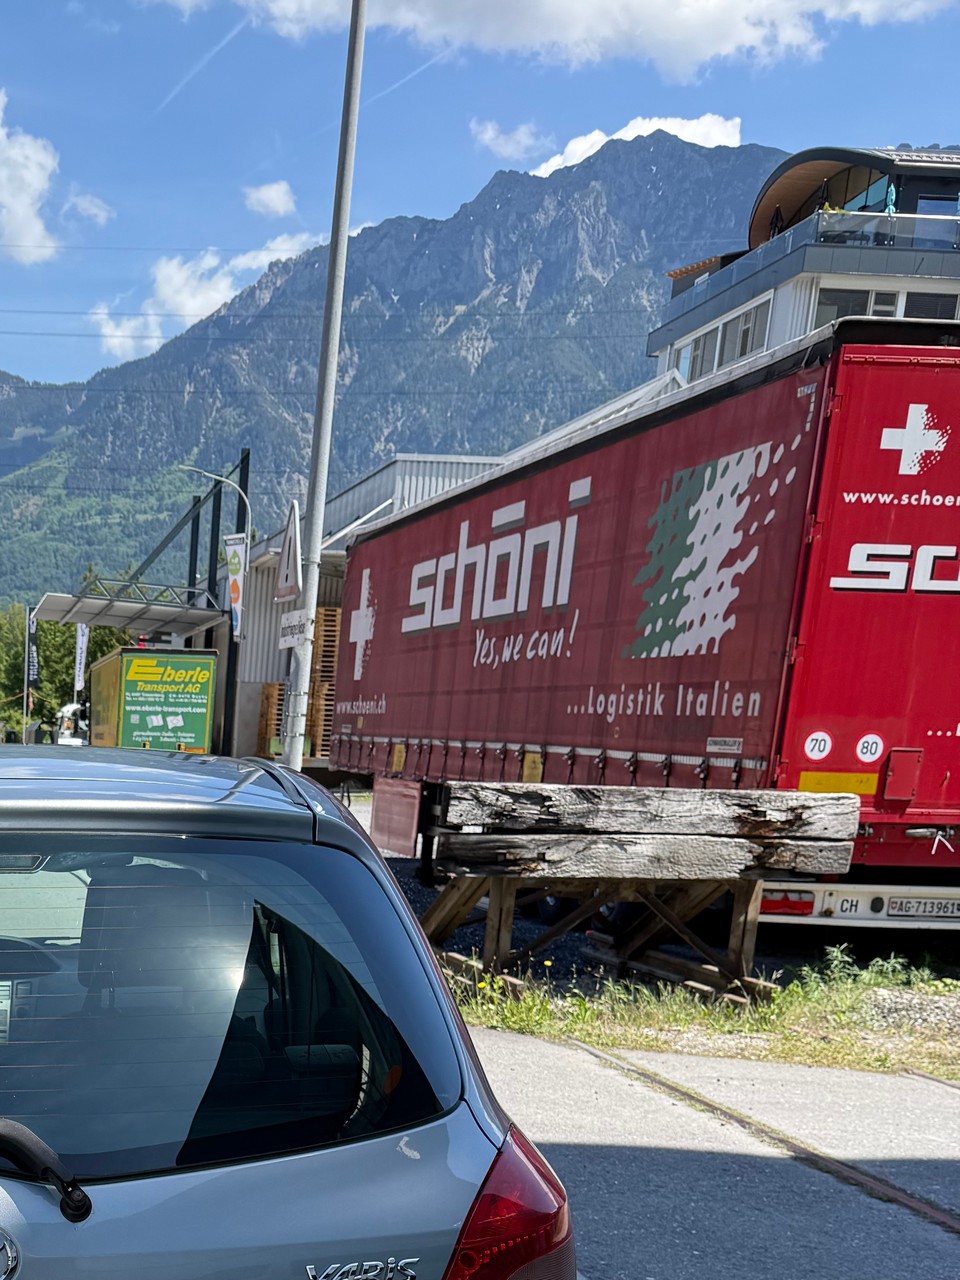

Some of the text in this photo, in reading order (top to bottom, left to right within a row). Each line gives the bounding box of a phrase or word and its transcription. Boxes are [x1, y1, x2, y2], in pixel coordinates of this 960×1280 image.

[473, 608, 579, 669] Yes, we can!
[126, 658, 210, 683] Eberle
[136, 681, 201, 694] Transport AG
[336, 693, 386, 714] www.schoeni.ch
[676, 679, 761, 717] Italien
[810, 739, 827, 753] 70
[860, 741, 878, 755] 80
[840, 899, 859, 913] CH
